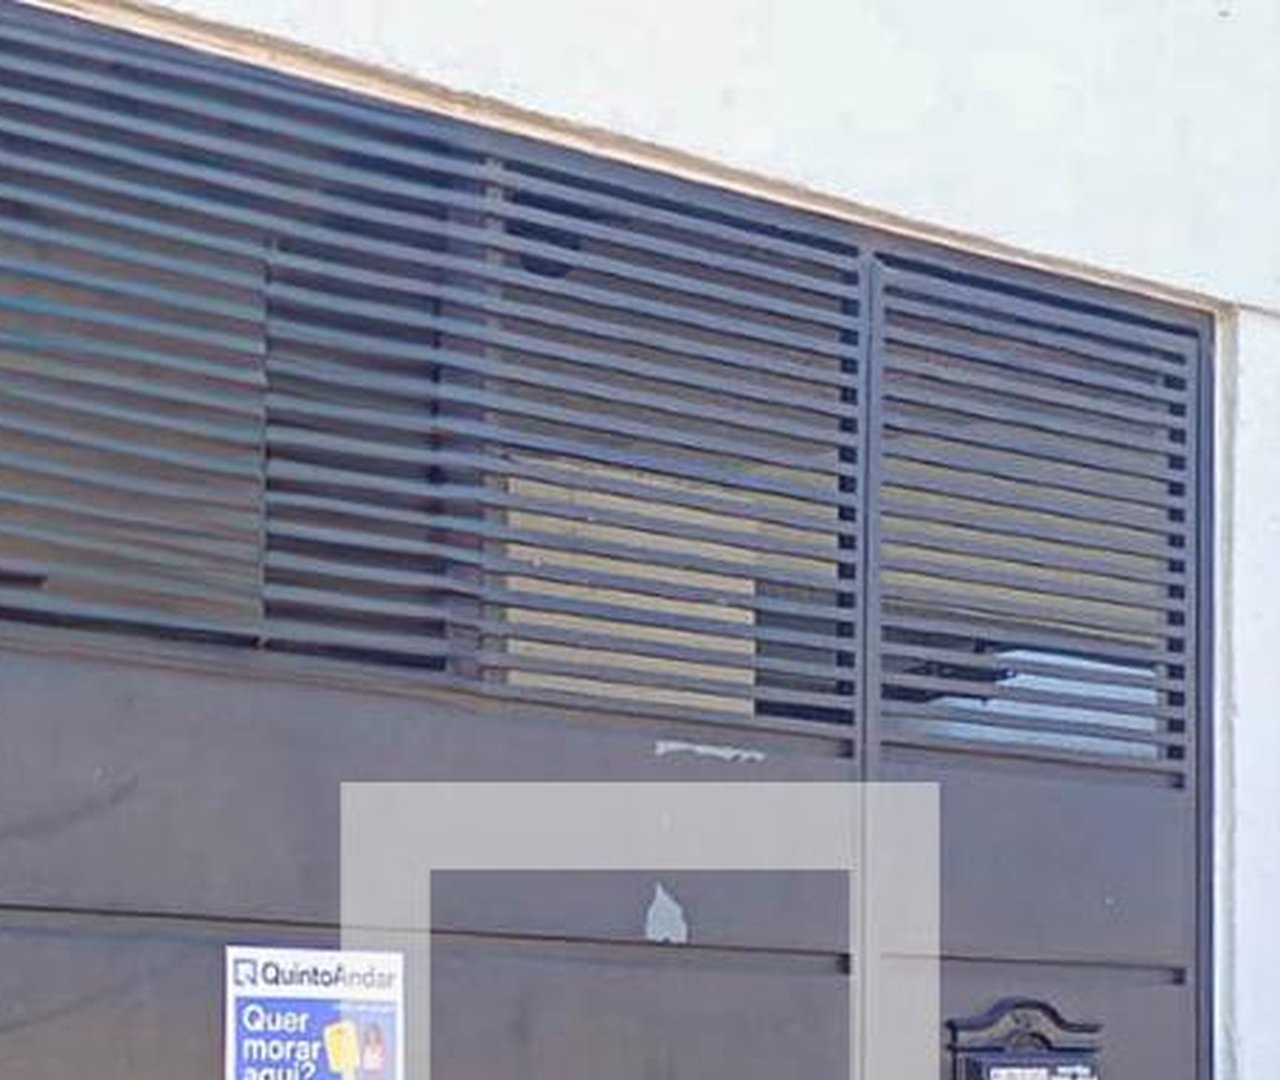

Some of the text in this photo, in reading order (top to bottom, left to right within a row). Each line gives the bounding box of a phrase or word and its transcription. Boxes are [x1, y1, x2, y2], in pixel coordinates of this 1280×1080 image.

[261, 961, 397, 989] QuintoAndar
[242, 1003, 310, 1033] Quer
[242, 1038, 322, 1063] morar
